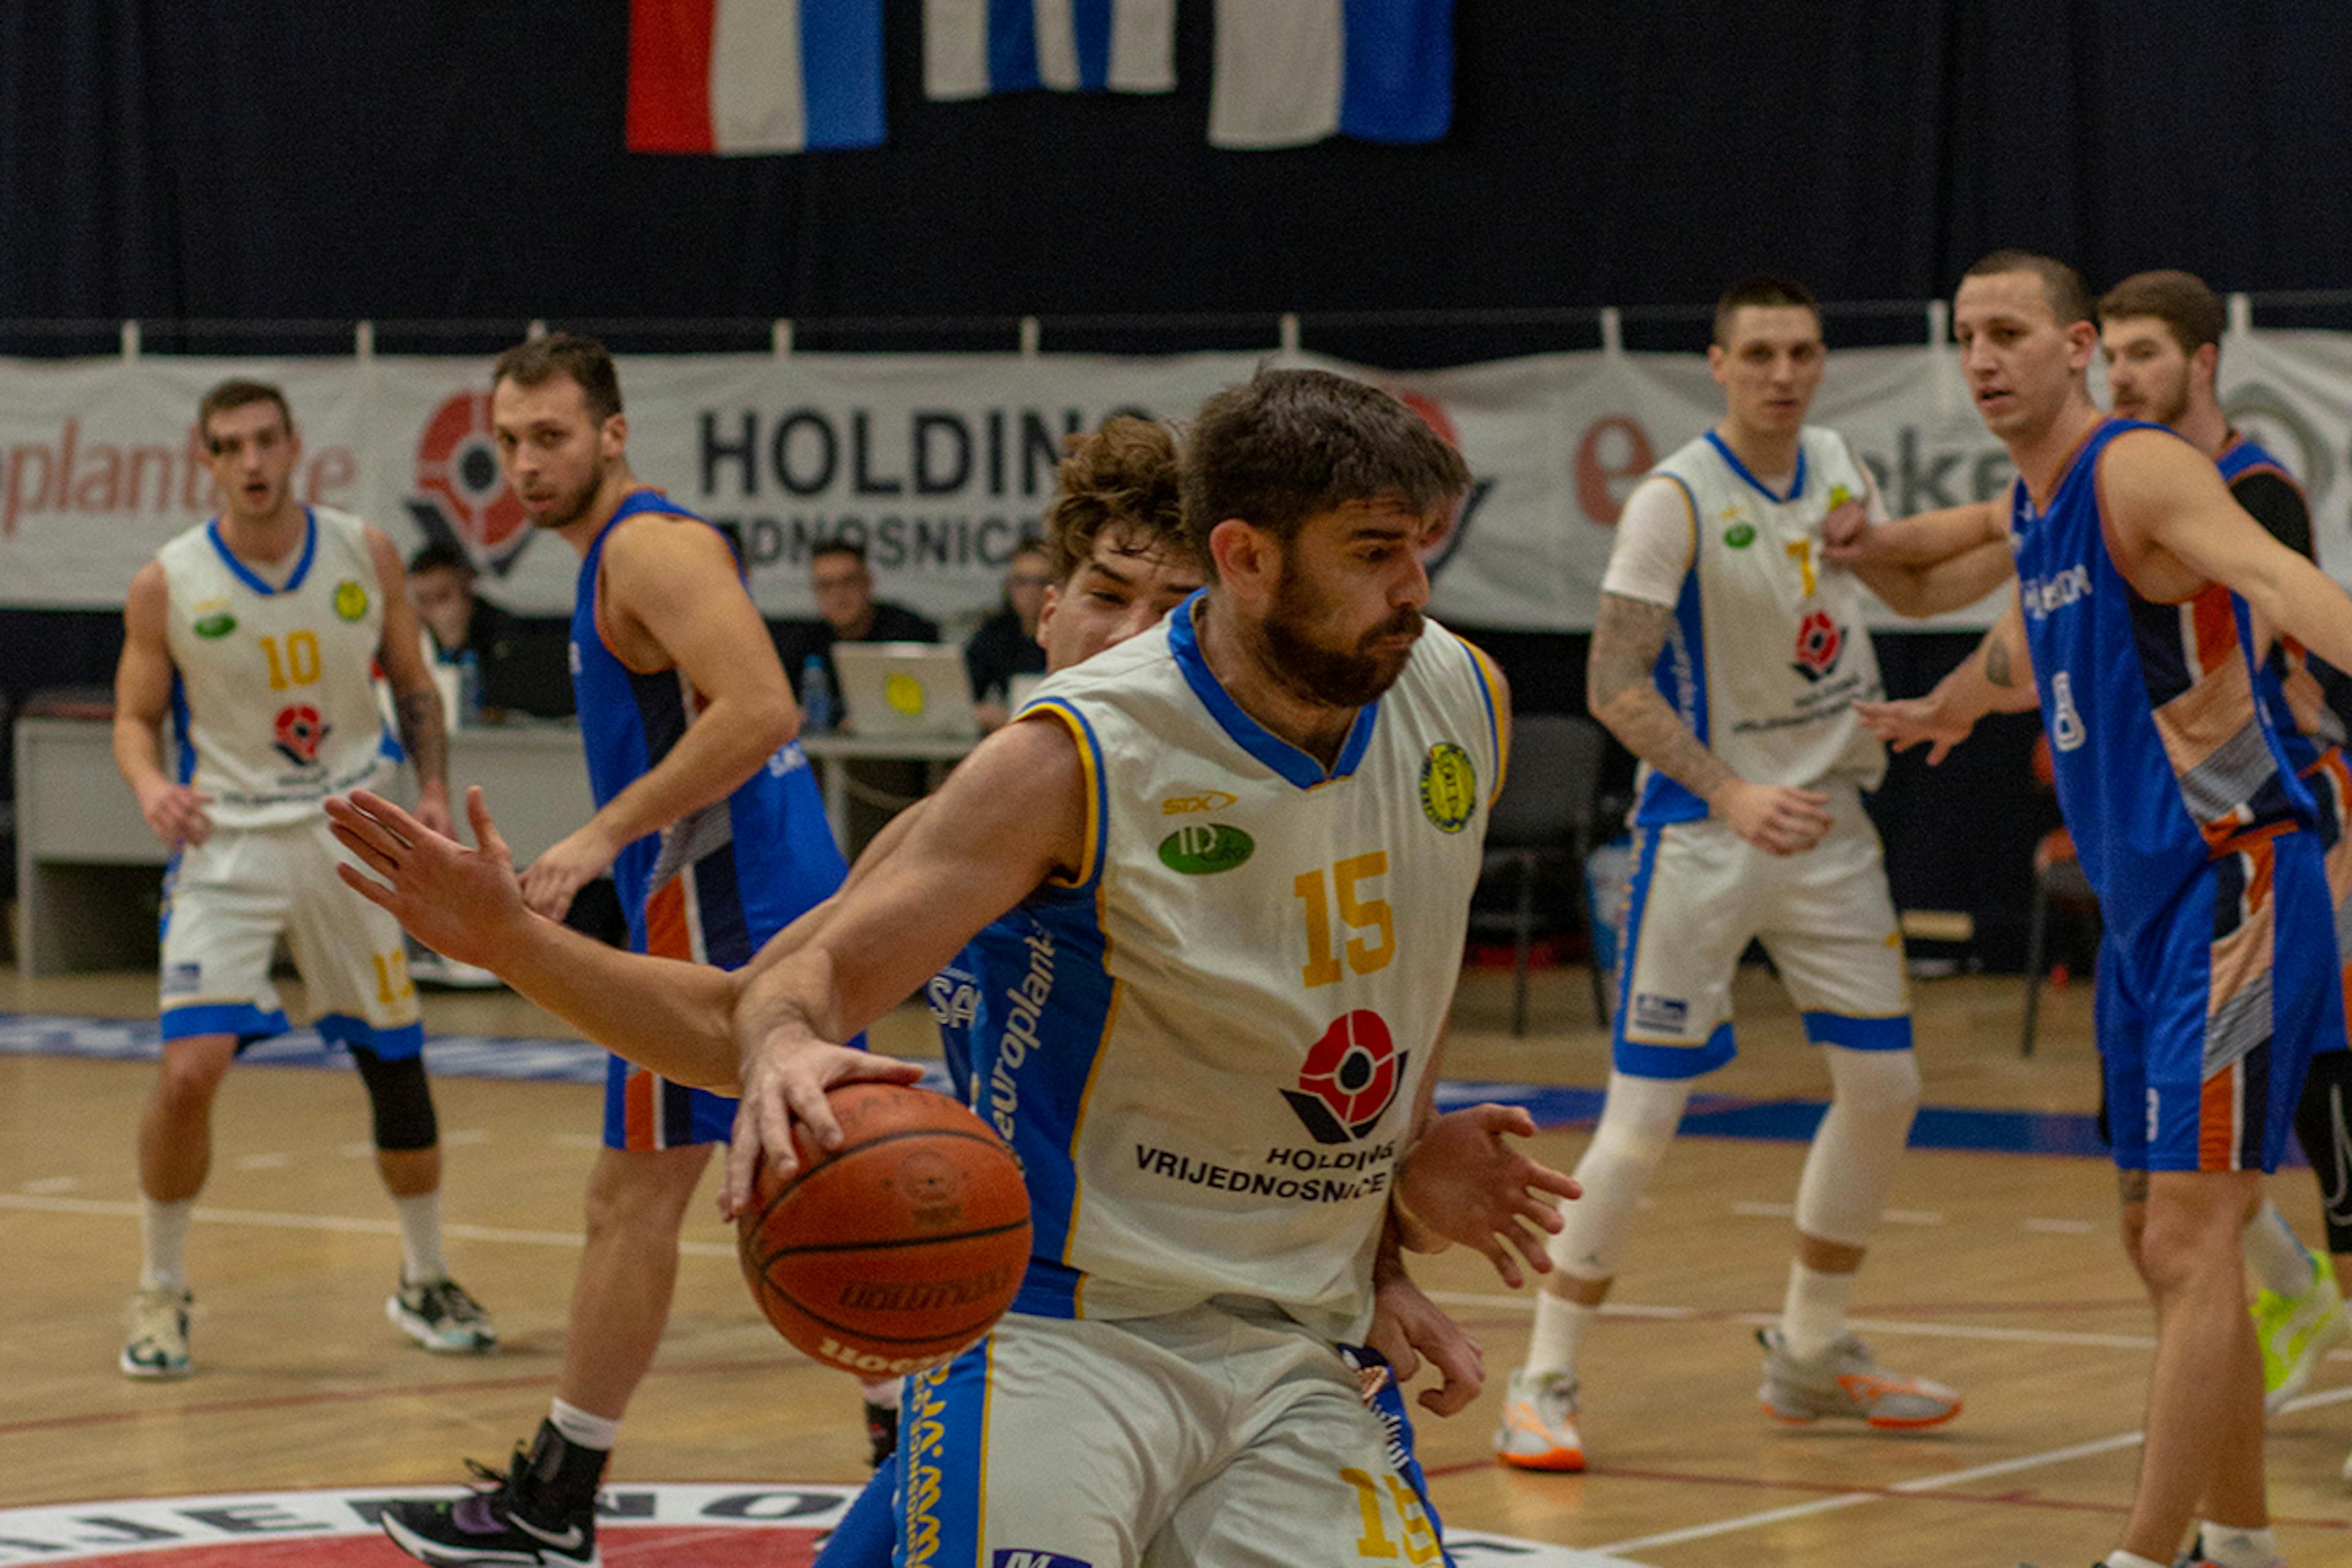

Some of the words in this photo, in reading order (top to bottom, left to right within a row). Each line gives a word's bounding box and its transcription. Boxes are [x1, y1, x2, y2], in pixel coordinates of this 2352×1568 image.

[700, 407, 1156, 497] HOLDIN
[260, 630, 322, 691] 10
[1294, 850, 1396, 989] 15
[1136, 1144, 1388, 1204] VRIJEDNOSNICE
[1266, 1140, 1396, 1171] HOLDING
